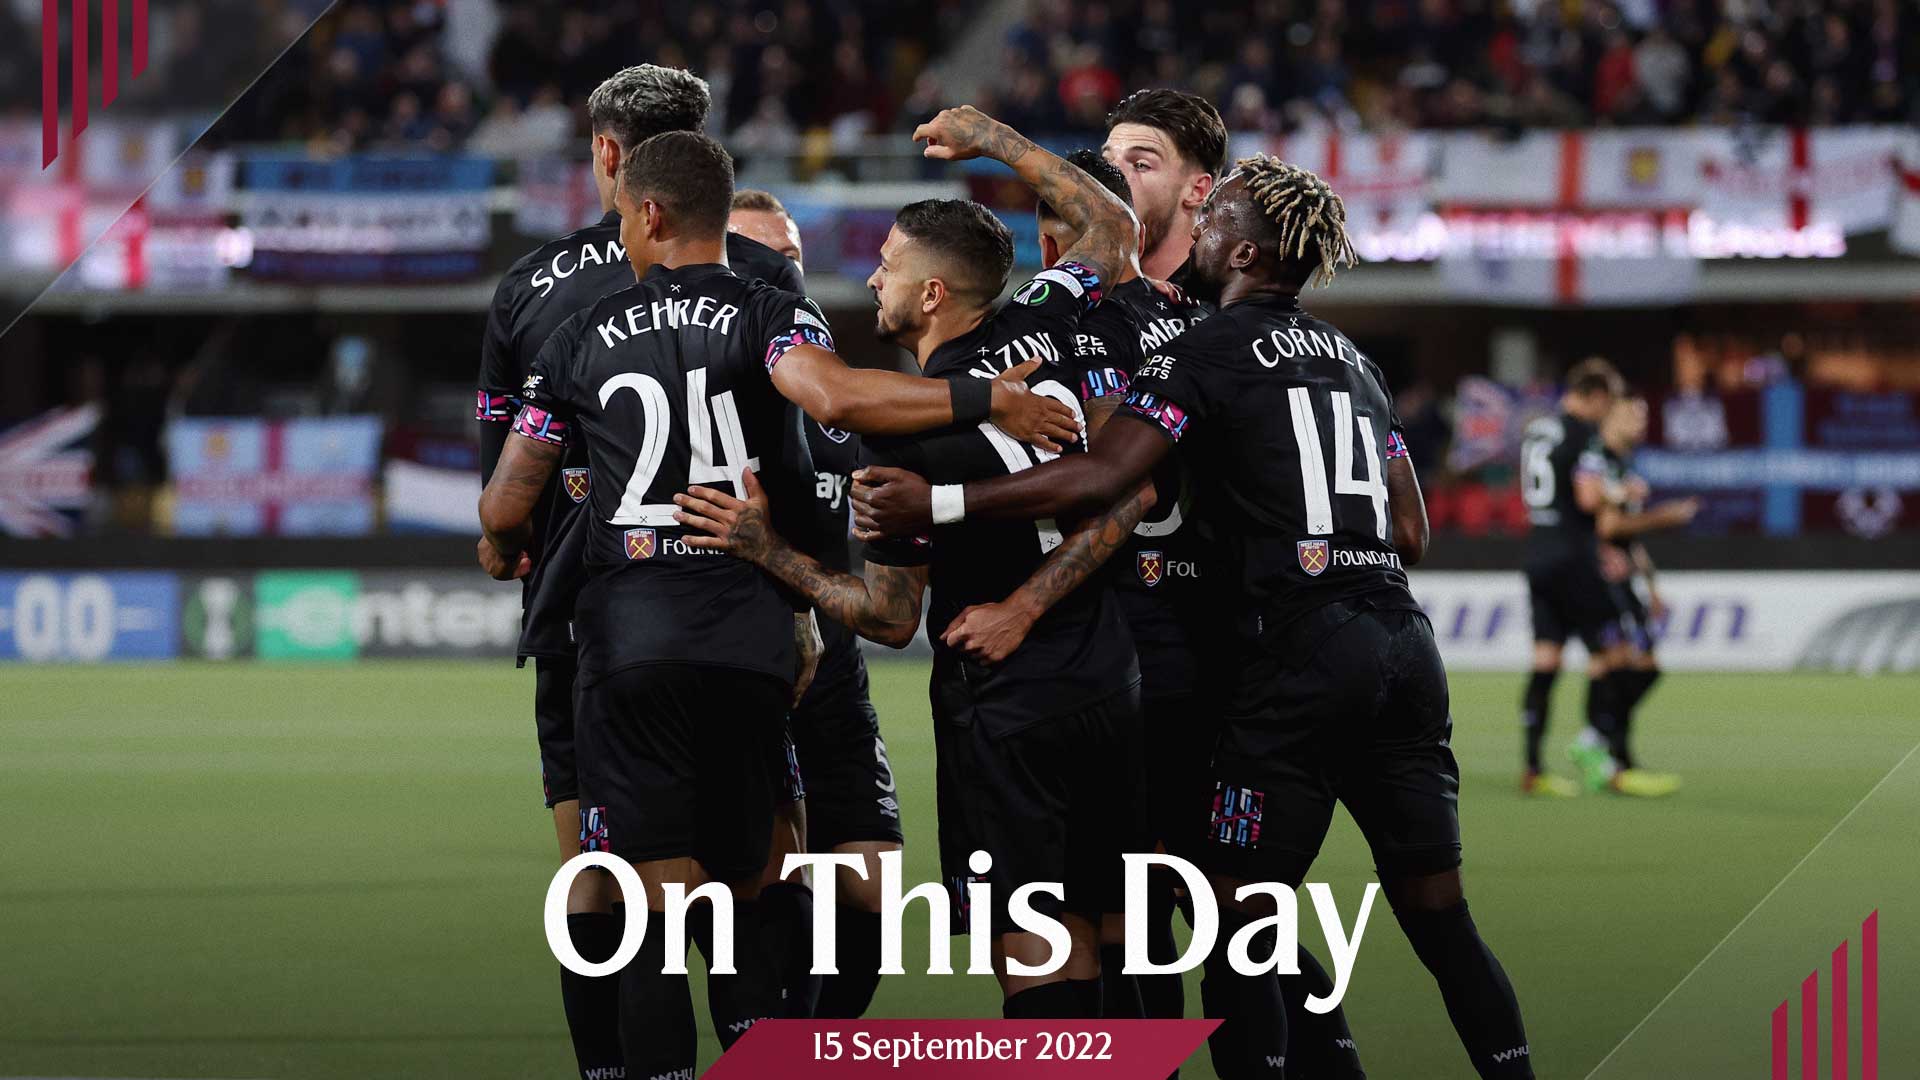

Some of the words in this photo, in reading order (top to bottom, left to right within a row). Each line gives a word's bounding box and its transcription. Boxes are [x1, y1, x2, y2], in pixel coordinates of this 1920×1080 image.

[596, 296, 739, 349] KEHRER
[1251, 327, 1366, 374] CORNET
[598, 366, 761, 526] 24
[1287, 387, 1388, 540] 14
[815, 471, 848, 510] ay
[1333, 549, 1404, 571] FOUNDATI
[874, 736, 896, 793] 5
[1494, 1045, 1529, 1064] WHU
